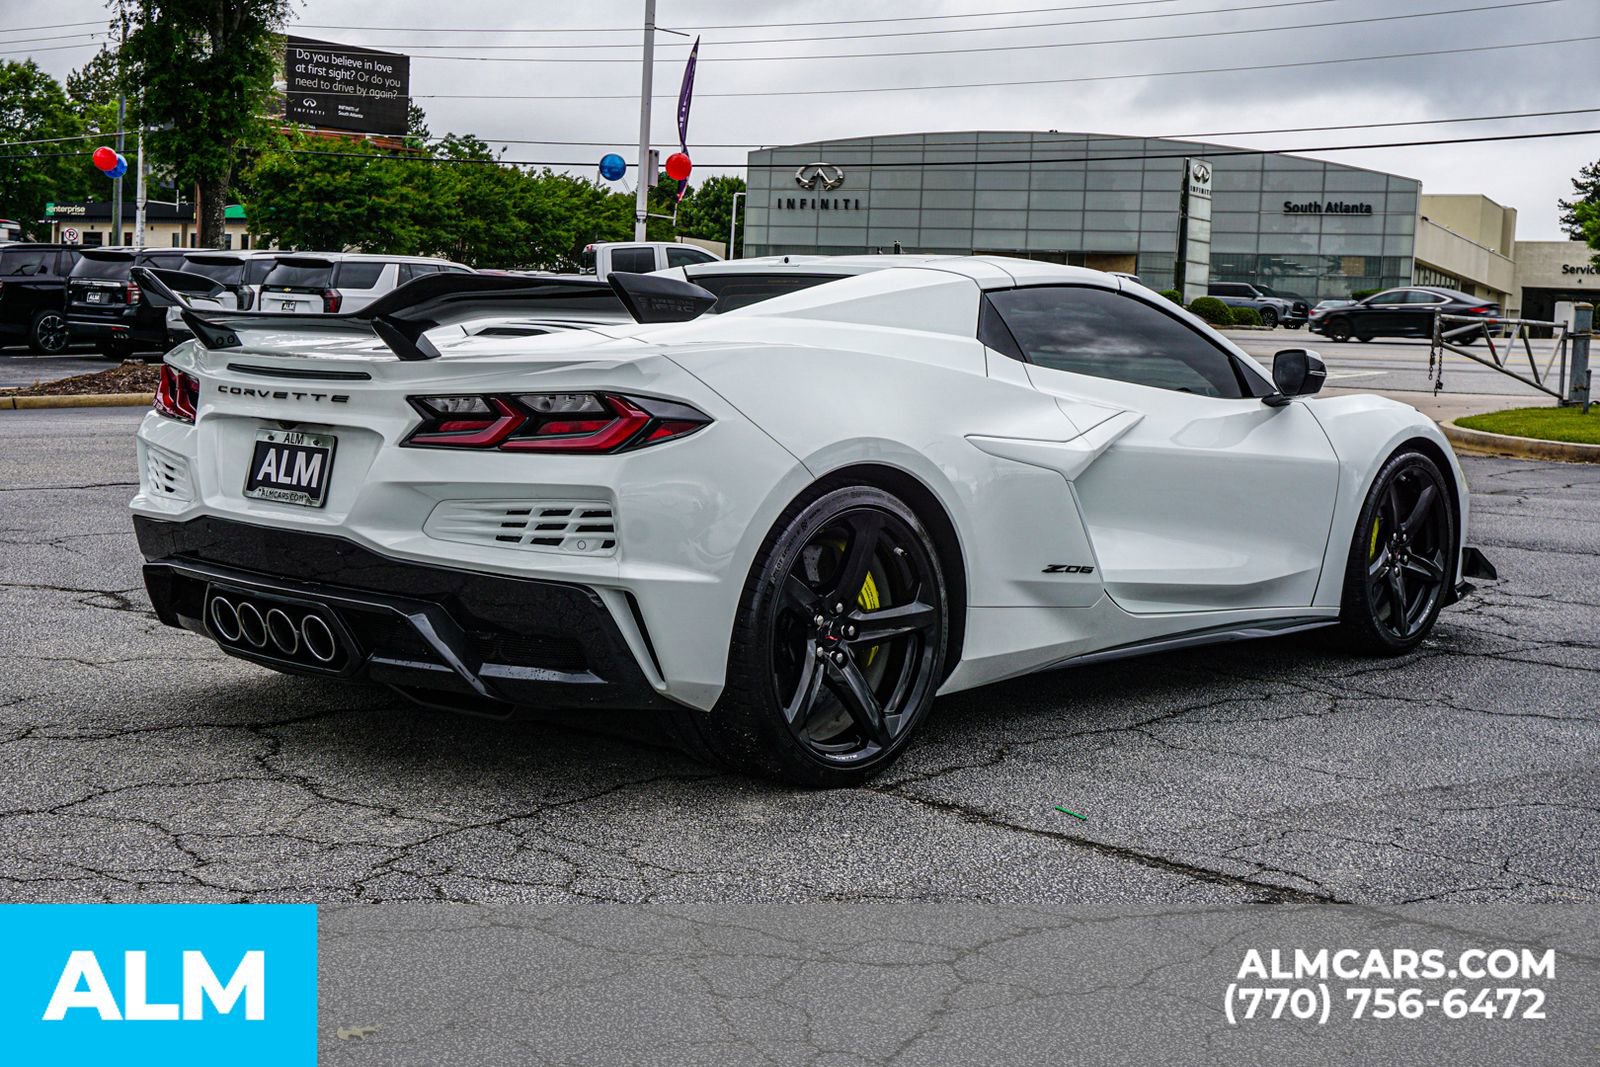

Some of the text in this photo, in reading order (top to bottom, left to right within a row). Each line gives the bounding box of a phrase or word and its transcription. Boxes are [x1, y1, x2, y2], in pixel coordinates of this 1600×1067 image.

[296, 48, 393, 73] Do you believe in love
[295, 64, 401, 88] at first sight? Or do you
[295, 77, 398, 100] need to drive by again?
[294, 107, 325, 116] INFINITI
[46, 205, 86, 214] enterprise
[777, 198, 860, 210] INFINITI
[1283, 201, 1373, 214] South Atlanta
[218, 385, 350, 403] CORVETTE
[283, 432, 304, 445] ALM
[256, 447, 323, 488] ALM
[1041, 564, 1095, 574] Z06
